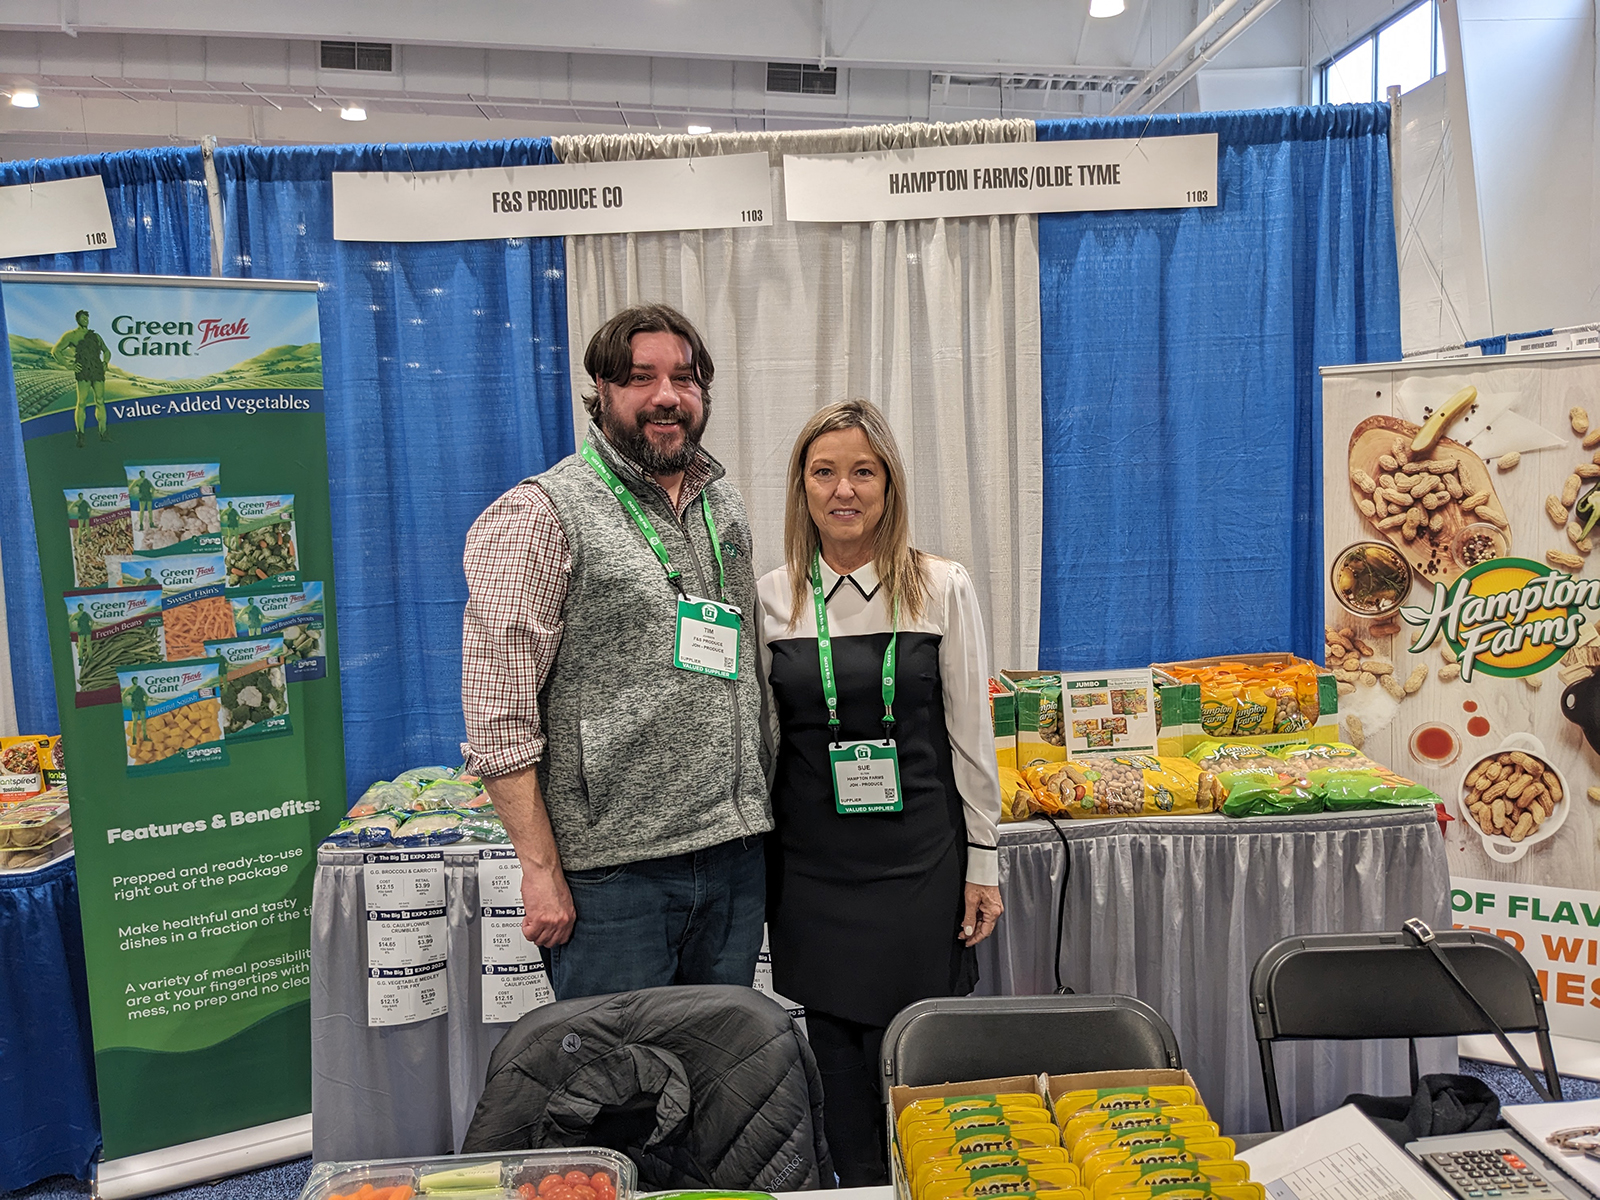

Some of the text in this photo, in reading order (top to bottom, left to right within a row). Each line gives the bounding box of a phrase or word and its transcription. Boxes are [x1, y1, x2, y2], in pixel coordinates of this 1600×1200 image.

[889, 163, 1121, 195] HAMPTON FARMS/OLDE TYME
[492, 186, 623, 214] F&S PRODUCE CO
[1186, 190, 1208, 204] 1103
[740, 209, 763, 223] 1103
[85, 232, 107, 246] 1103
[111, 315, 251, 347] Green Fresh
[118, 335, 192, 357] Giant
[113, 395, 310, 420] Value-Added Vegetables
[152, 470, 185, 480] Green
[154, 479, 185, 488] Giant
[89, 492, 118, 501] Green
[92, 500, 117, 508] Giant
[238, 501, 265, 510] Green
[240, 508, 264, 516] Giant
[160, 566, 215, 579] Green Fresh
[163, 577, 193, 586] Giant
[167, 586, 219, 605] Sweet Fixin's
[260, 596, 288, 605] Green
[90, 599, 148, 611] Green Fresh
[262, 603, 288, 612] Giant
[1400, 570, 1600, 653] Hampton
[93, 610, 125, 619] Giant
[96, 626, 120, 639] French
[121, 619, 142, 631] Beans
[703, 638, 723, 647] PRODUCE
[704, 645, 724, 653] PRODUCE
[1457, 613, 1586, 683] Farms
[227, 647, 254, 656] Green
[229, 654, 254, 662] Giant
[681, 656, 701, 664] SUPPLIER
[682, 663, 730, 677] VALUED SUPPLIER
[145, 671, 202, 686] Green Fresh
[147, 684, 179, 695] Giant
[1235, 713, 1263, 731] Farms
[107, 800, 321, 845] Features & Benefits:
[112, 847, 303, 887] Prepped and ready-to-use
[114, 863, 289, 901] right out of the package
[1451, 889, 1600, 928] OF FLAV
[118, 897, 297, 938] Make healthful and tasty
[119, 909, 300, 951] dishes in a fraction of the
[1541, 934, 1598, 966] WI
[125, 949, 312, 994] A variety of meal possibilit
[431, 962, 444, 970] 2025
[126, 962, 310, 1007] are at your fingertips with
[388, 973, 440, 985] VEGETABLE MEDLEY
[504, 980, 541, 988] CAULIFLOWER
[421, 992, 436, 1000] $3.99
[535, 990, 550, 998] $3.99
[128, 983, 279, 1021] mess, no prep and no
[764, 1154, 804, 1193] Marmot
